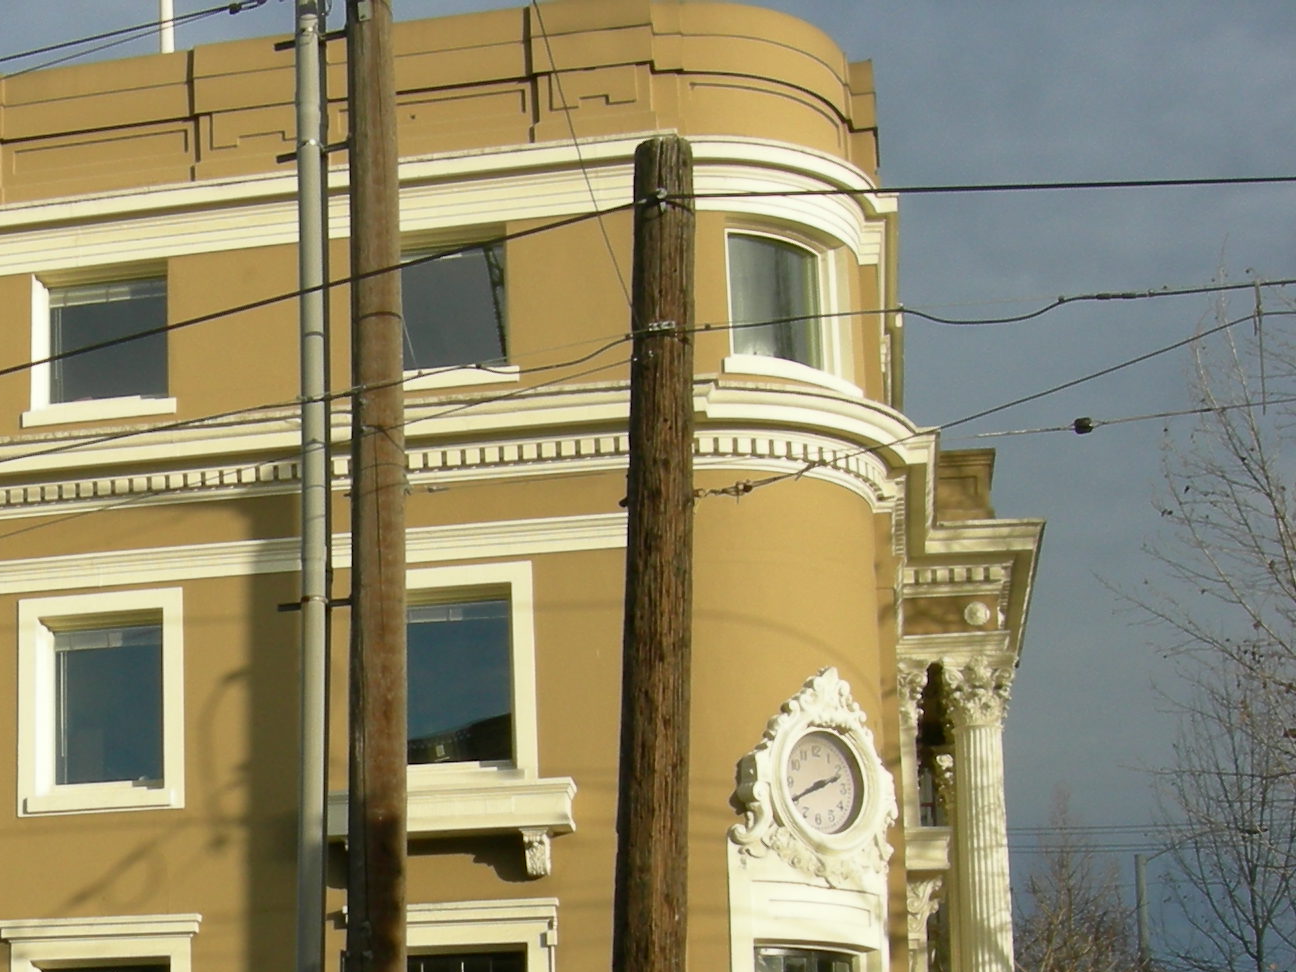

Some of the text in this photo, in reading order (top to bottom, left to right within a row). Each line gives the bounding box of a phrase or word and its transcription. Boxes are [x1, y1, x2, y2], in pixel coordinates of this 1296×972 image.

[800, 751, 808, 761] 11
[811, 745, 821, 757] 12
[791, 759, 800, 771] 10
[787, 775, 794, 788] 9
[840, 783, 847, 795] 3
[836, 801, 844, 811] 4
[815, 813, 822, 825] 6
